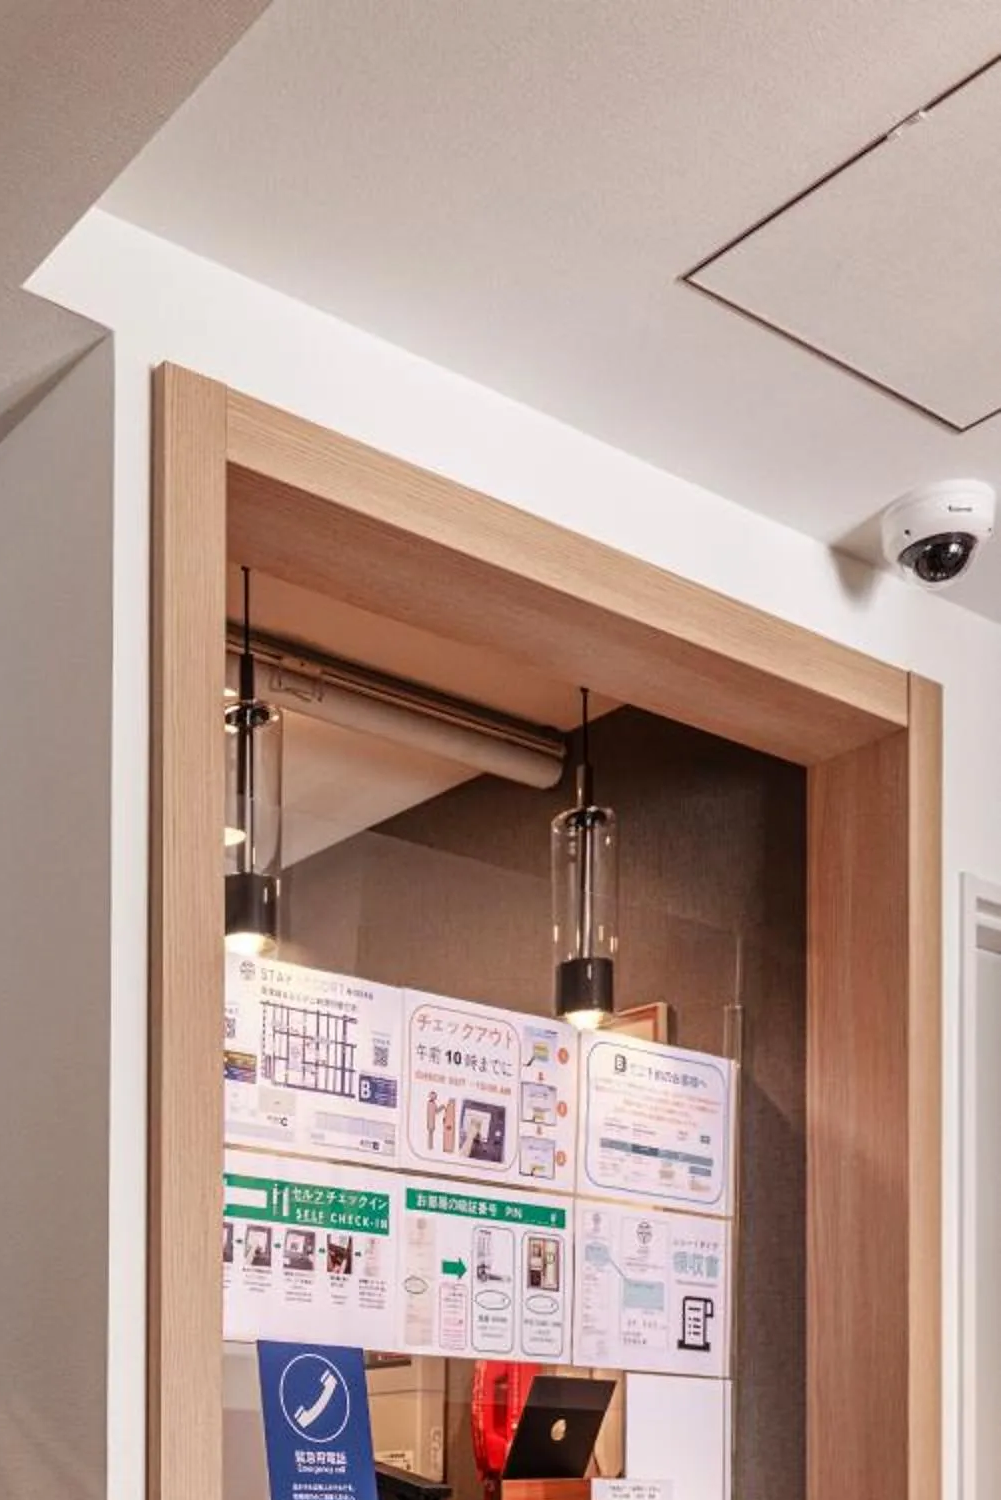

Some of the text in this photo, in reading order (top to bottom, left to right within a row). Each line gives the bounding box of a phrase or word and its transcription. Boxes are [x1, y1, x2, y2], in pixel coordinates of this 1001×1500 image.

[416, 1013, 513, 1049] チェックアウト
[292, 1185, 388, 1212] セルフチェックイン
[296, 1209, 388, 1230] SELF CHECK-IN
